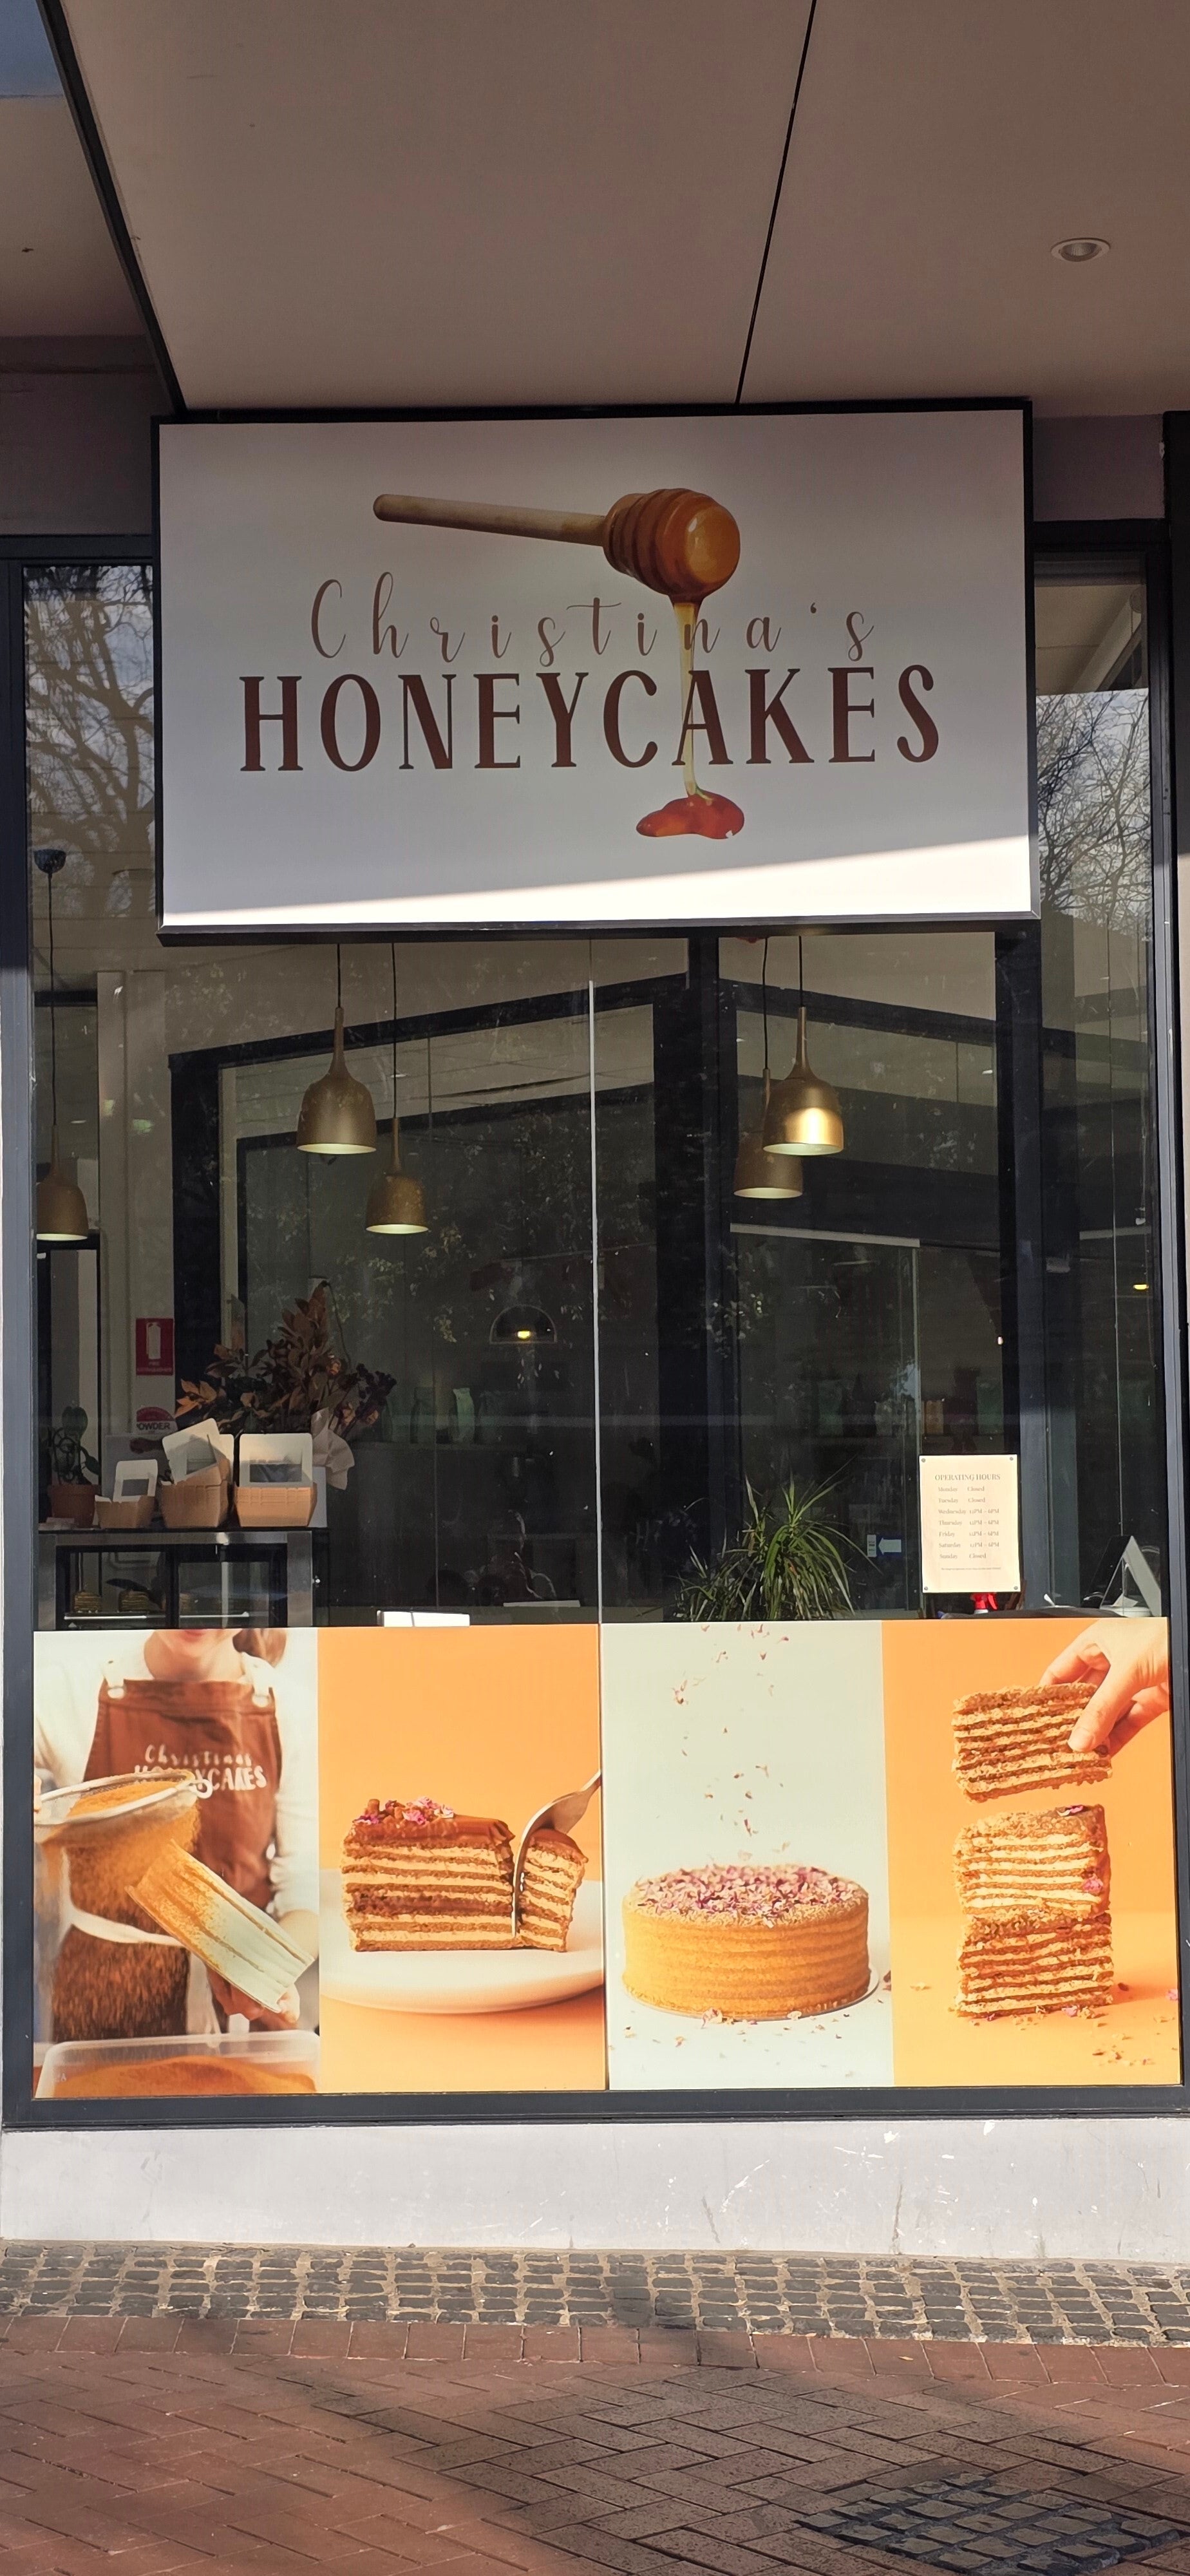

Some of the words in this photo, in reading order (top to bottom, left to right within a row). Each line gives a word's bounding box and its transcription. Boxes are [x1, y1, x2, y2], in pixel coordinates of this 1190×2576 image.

[310, 572, 875, 668] Christina's
[239, 664, 940, 772] HONEYCAKES
[134, 1765, 268, 1792] YCAKES
